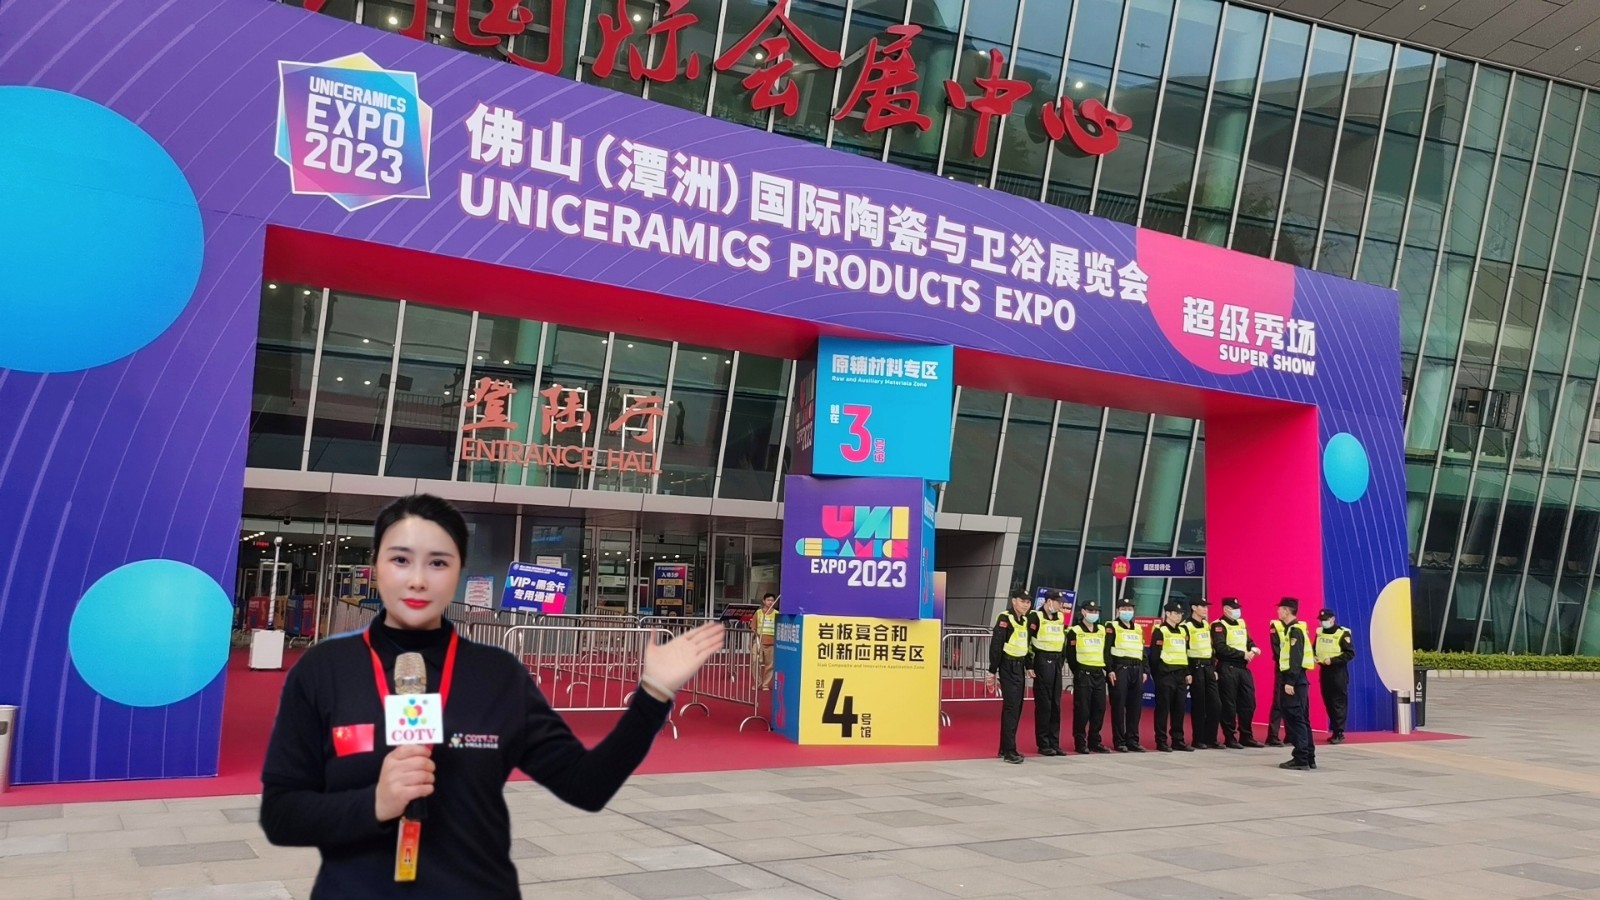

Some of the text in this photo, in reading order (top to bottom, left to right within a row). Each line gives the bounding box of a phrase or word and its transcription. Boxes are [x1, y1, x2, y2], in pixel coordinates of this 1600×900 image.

[309, 76, 407, 113] UNICERAMICS
[306, 94, 406, 149] EXPO
[303, 131, 403, 185] 2023
[460, 172, 1077, 331] UNICERAMICS PRODUCTS EXPO
[1182, 296, 1317, 357] 超级秀场
[832, 354, 939, 380] 原辅材料专区
[1219, 343, 1316, 377] SUPER SHOW
[884, 379, 913, 387] Materials
[461, 376, 665, 444] 登陆厅
[839, 403, 873, 463] 3
[461, 437, 663, 475] ENTRANCE HALL
[822, 505, 910, 539] UNI
[795, 537, 909, 558] CERAMICS
[810, 558, 848, 575] EXPO
[847, 559, 907, 588] 2023
[514, 588, 556, 604] 专用通道
[818, 623, 907, 642] 岩板复合和
[817, 642, 925, 662] 创新应用专区
[821, 677, 858, 738] 4
[391, 728, 437, 742] COTV
[860, 713, 872, 739] 号馆
